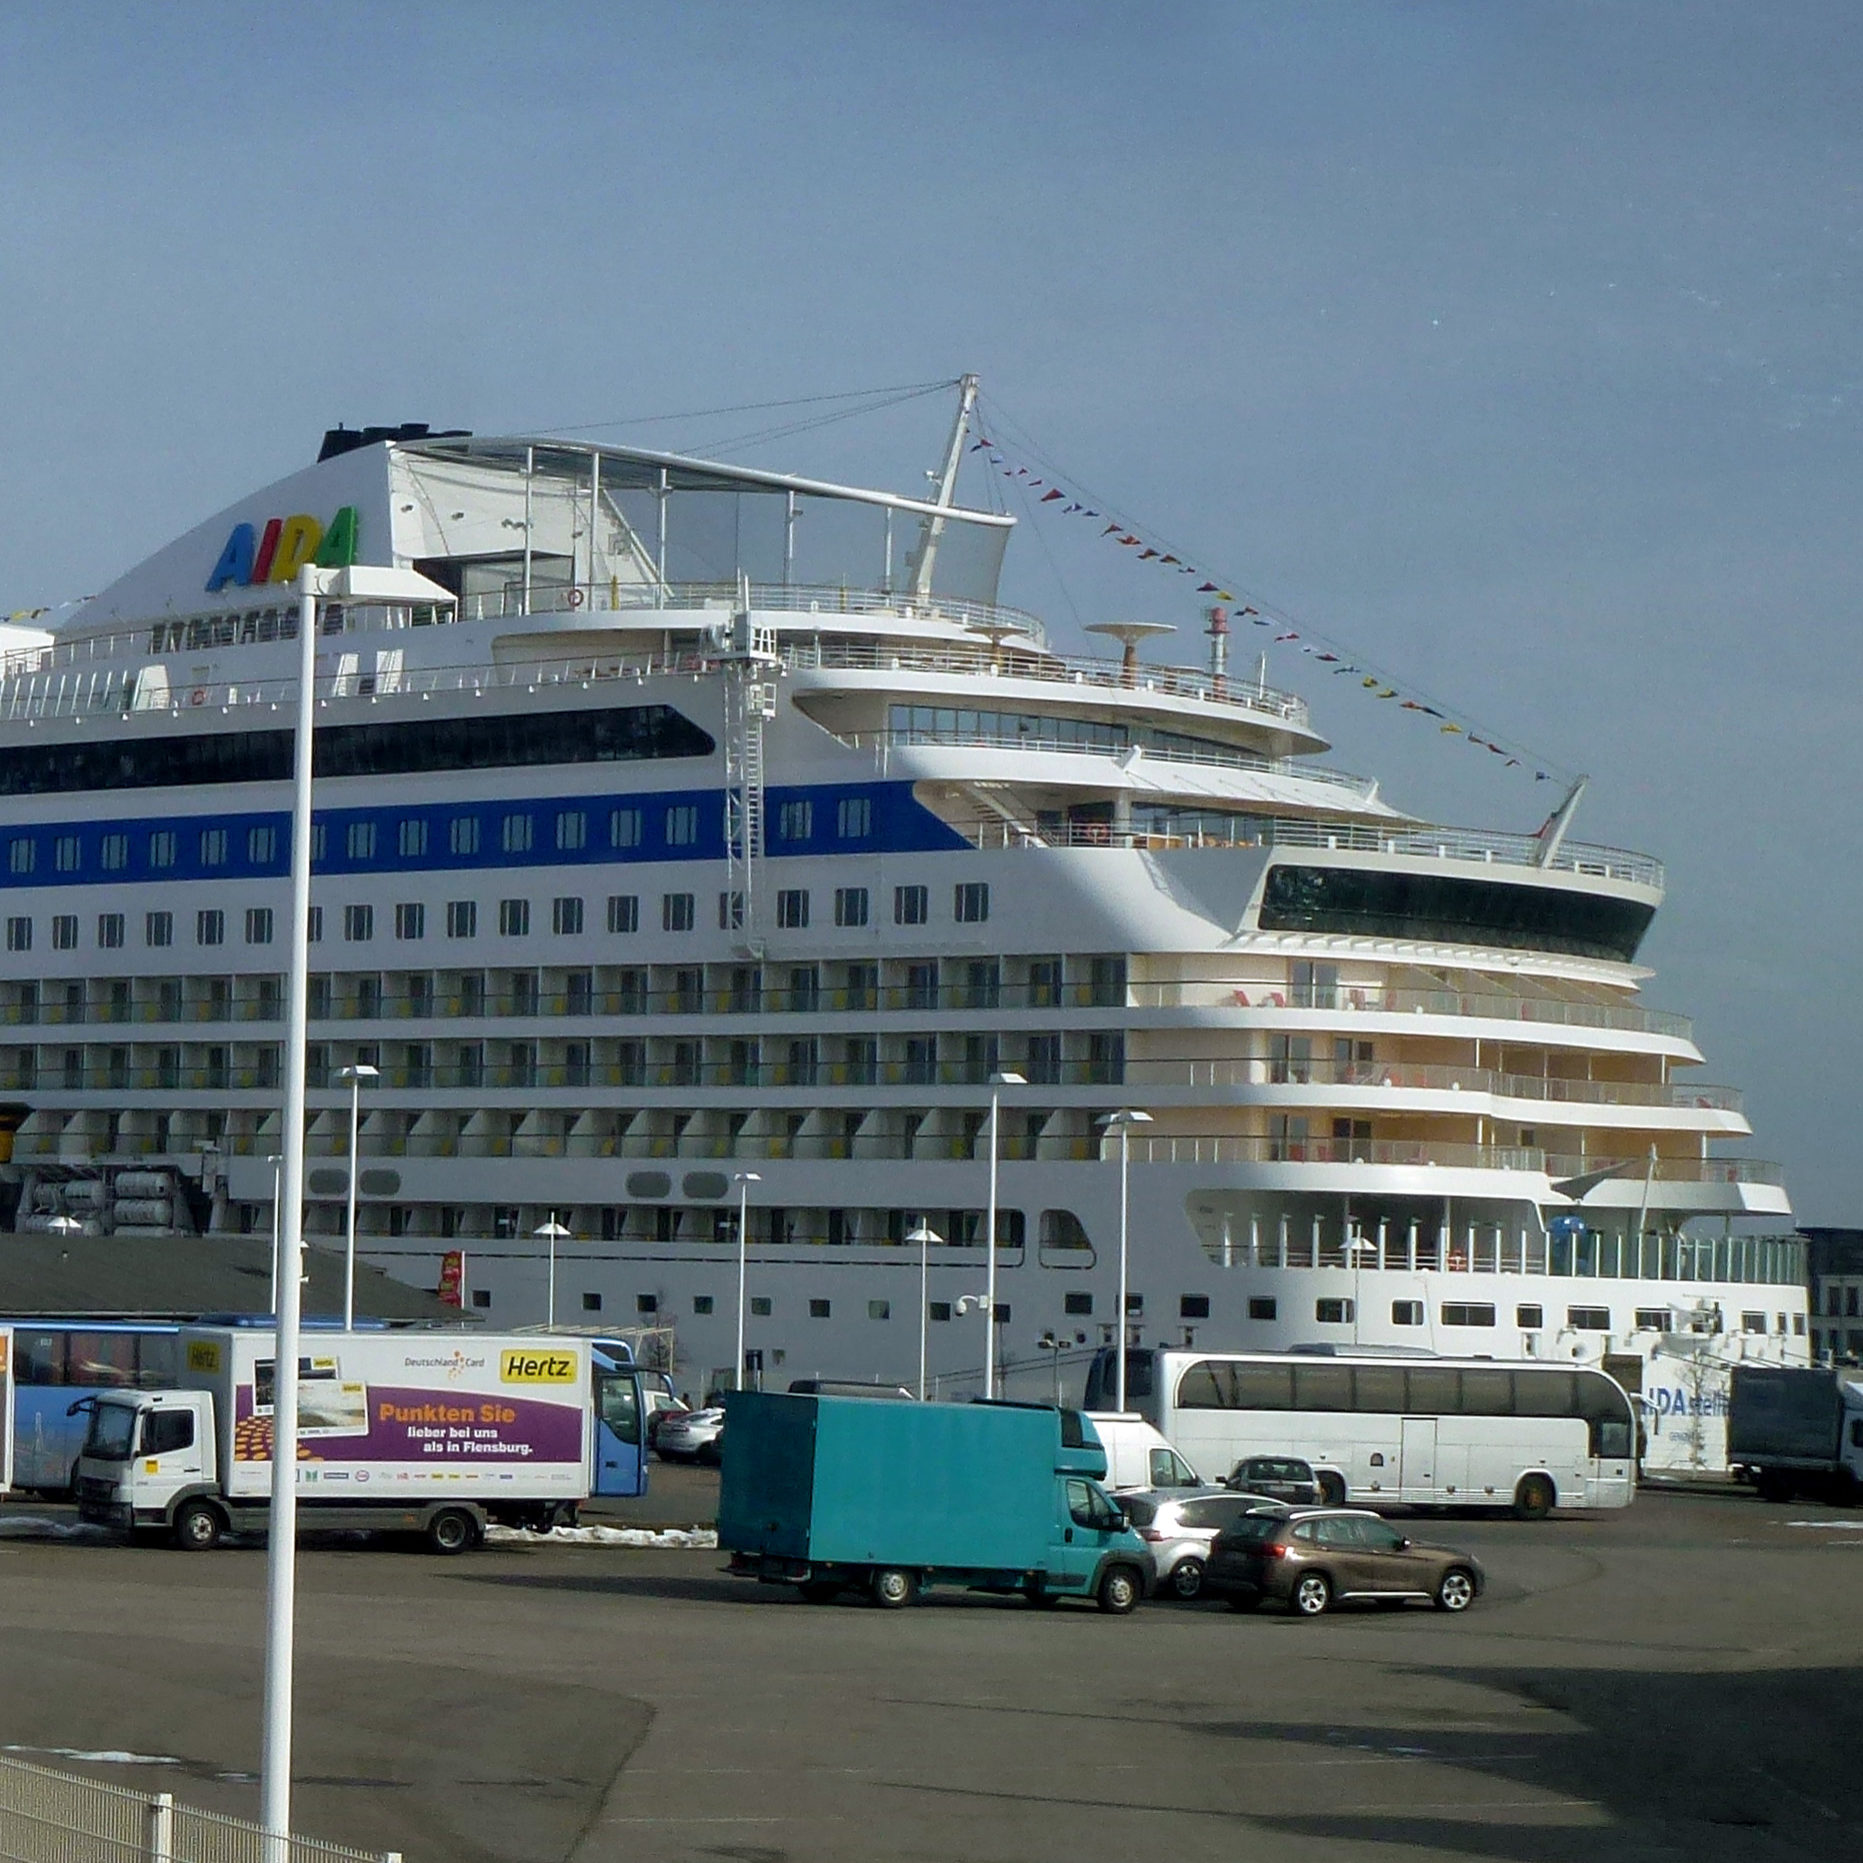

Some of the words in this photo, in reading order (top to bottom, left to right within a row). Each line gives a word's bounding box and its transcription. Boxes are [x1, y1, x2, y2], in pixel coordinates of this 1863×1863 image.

[204, 505, 359, 593] AIDA
[405, 1357, 459, 1367] Deutschland
[465, 1357, 485, 1367] Card
[507, 1357, 571, 1377] Hertz
[379, 1403, 475, 1423] Punkten
[480, 1404, 516, 1423] Sie
[407, 1427, 446, 1438] lieber
[449, 1427, 470, 1438] bei
[474, 1430, 498, 1438] uns
[423, 1441, 443, 1453] als
[447, 1441, 460, 1452] in
[463, 1441, 533, 1456] Flensburg.
